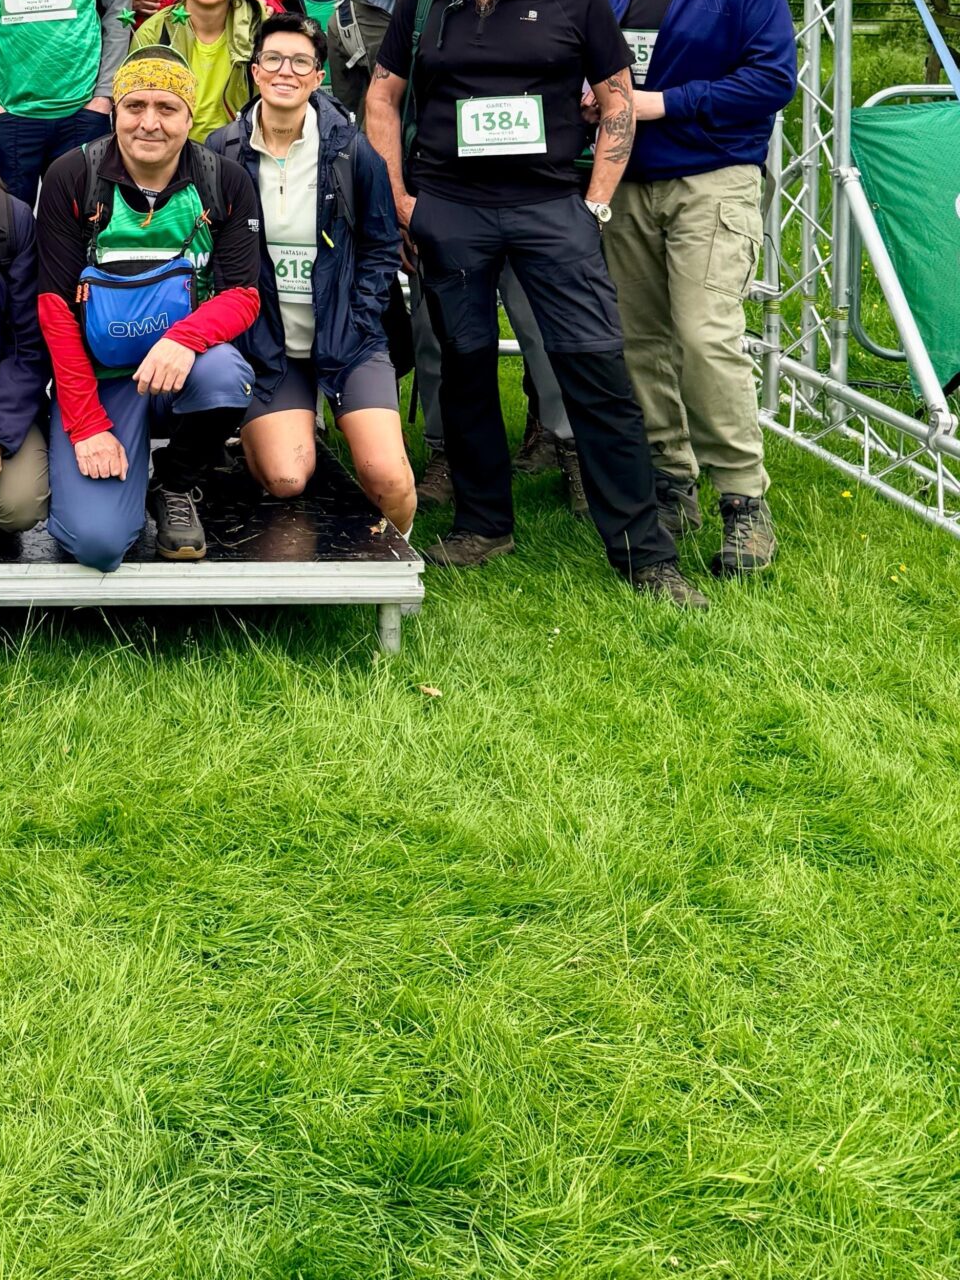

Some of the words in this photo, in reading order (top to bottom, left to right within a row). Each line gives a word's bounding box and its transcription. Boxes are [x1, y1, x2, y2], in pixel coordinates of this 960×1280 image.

[471, 111, 530, 131] 1384
[275, 258, 313, 279] 618
[107, 312, 170, 338] OMM
